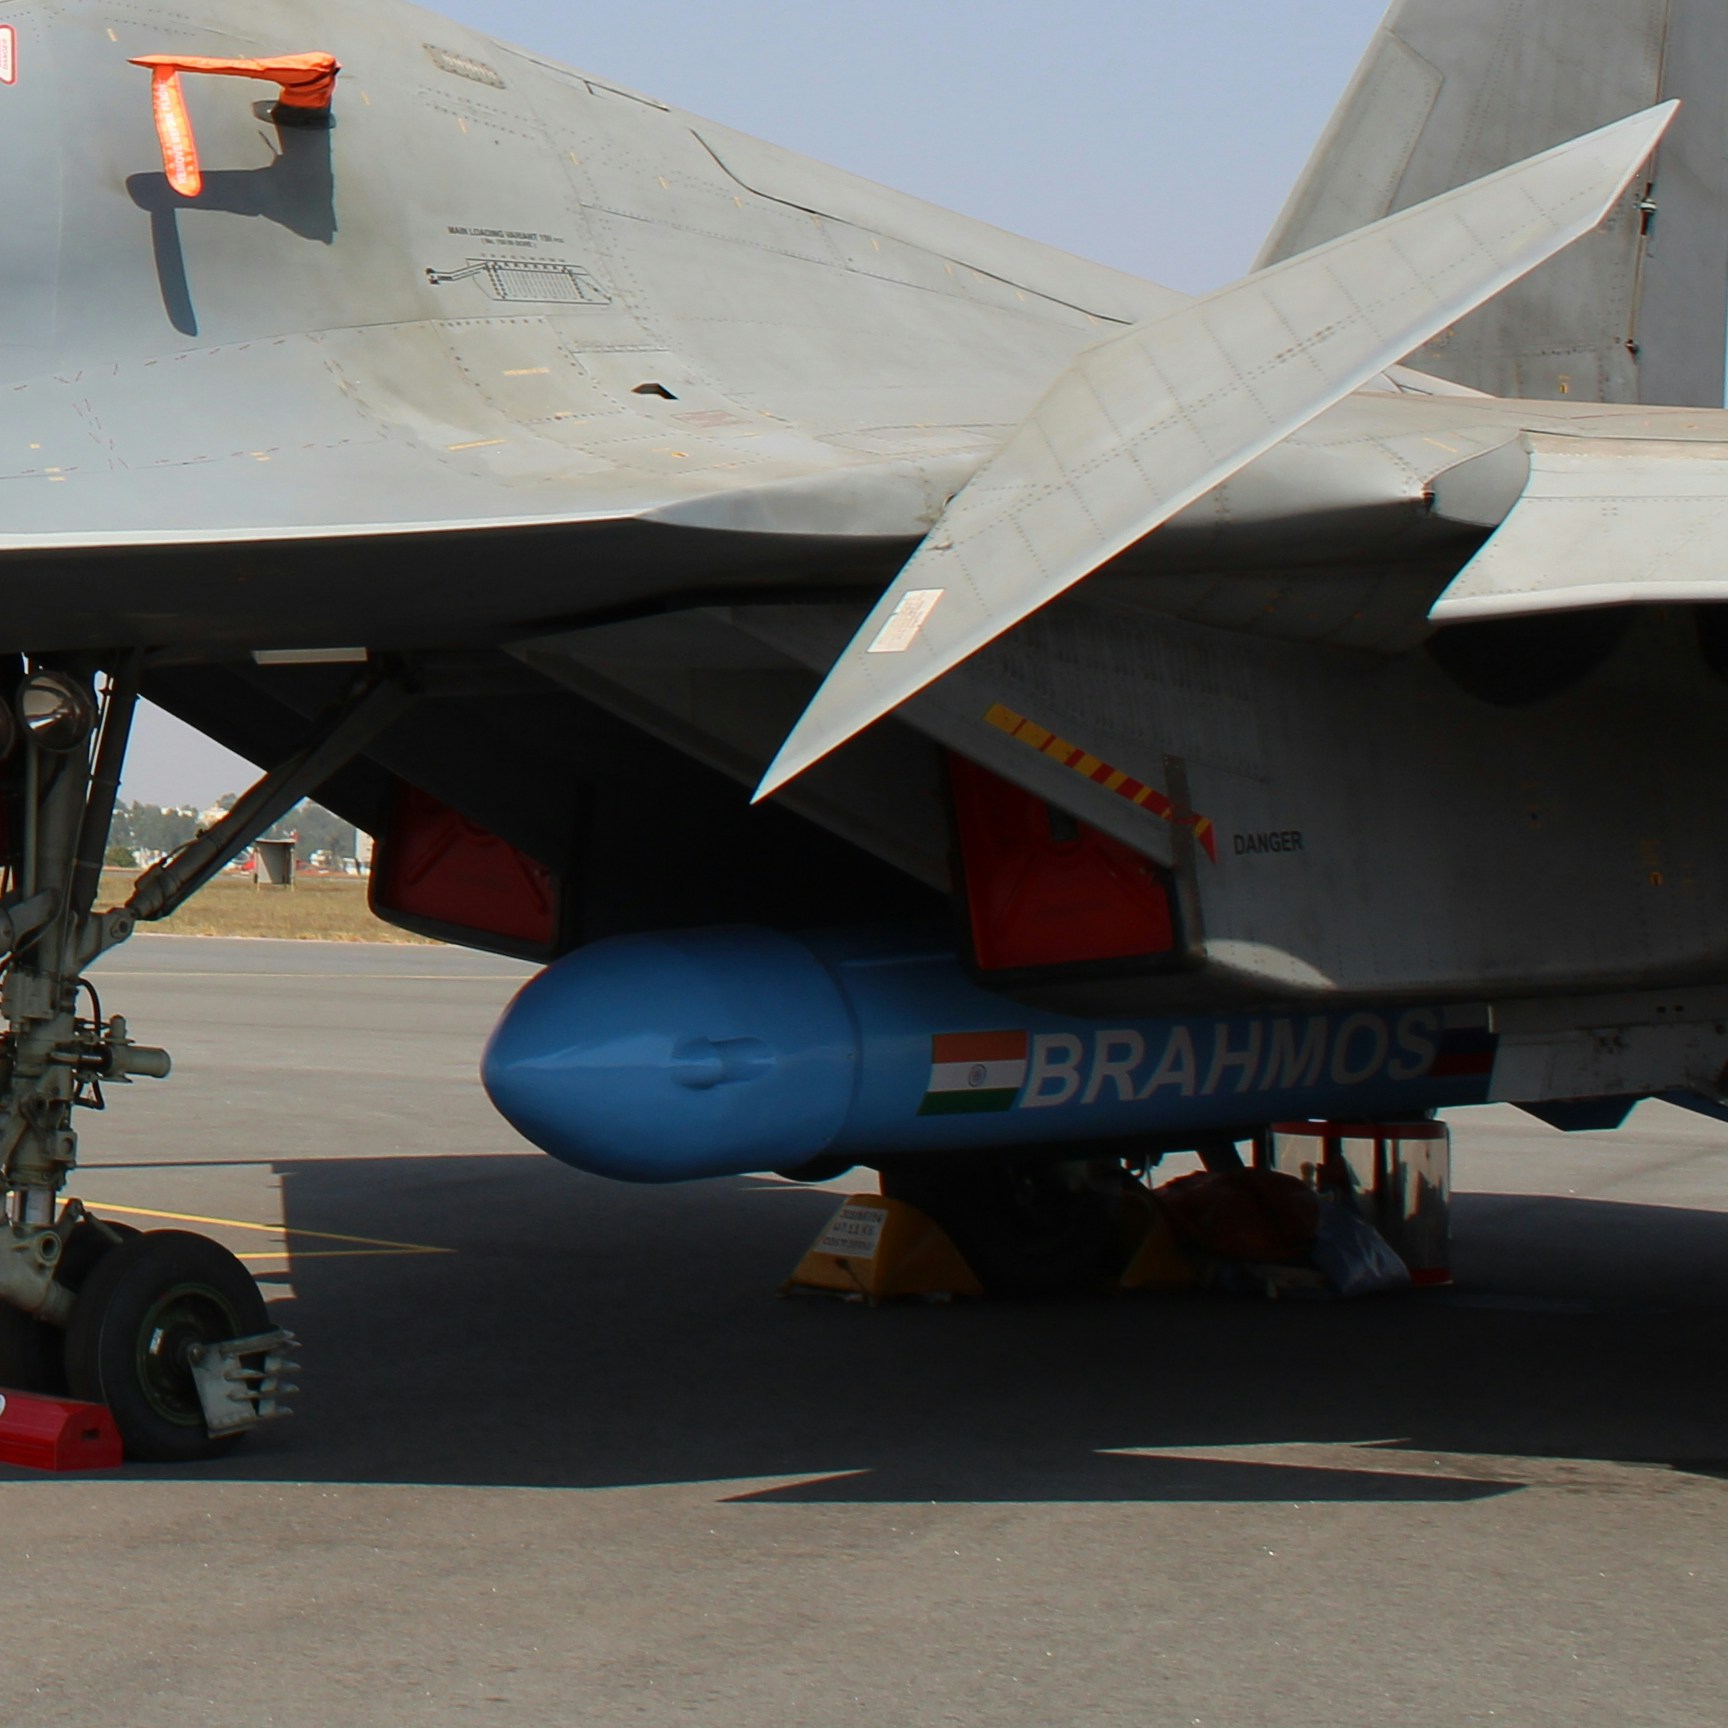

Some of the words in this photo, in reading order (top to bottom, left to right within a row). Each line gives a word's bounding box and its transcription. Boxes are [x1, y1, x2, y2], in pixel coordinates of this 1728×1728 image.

[172, 145, 187, 184] REMOVE
[469, 228, 505, 238] LOADING
[1233, 830, 1304, 855] DANGER
[1019, 1007, 1440, 1109] BRAHMOS
